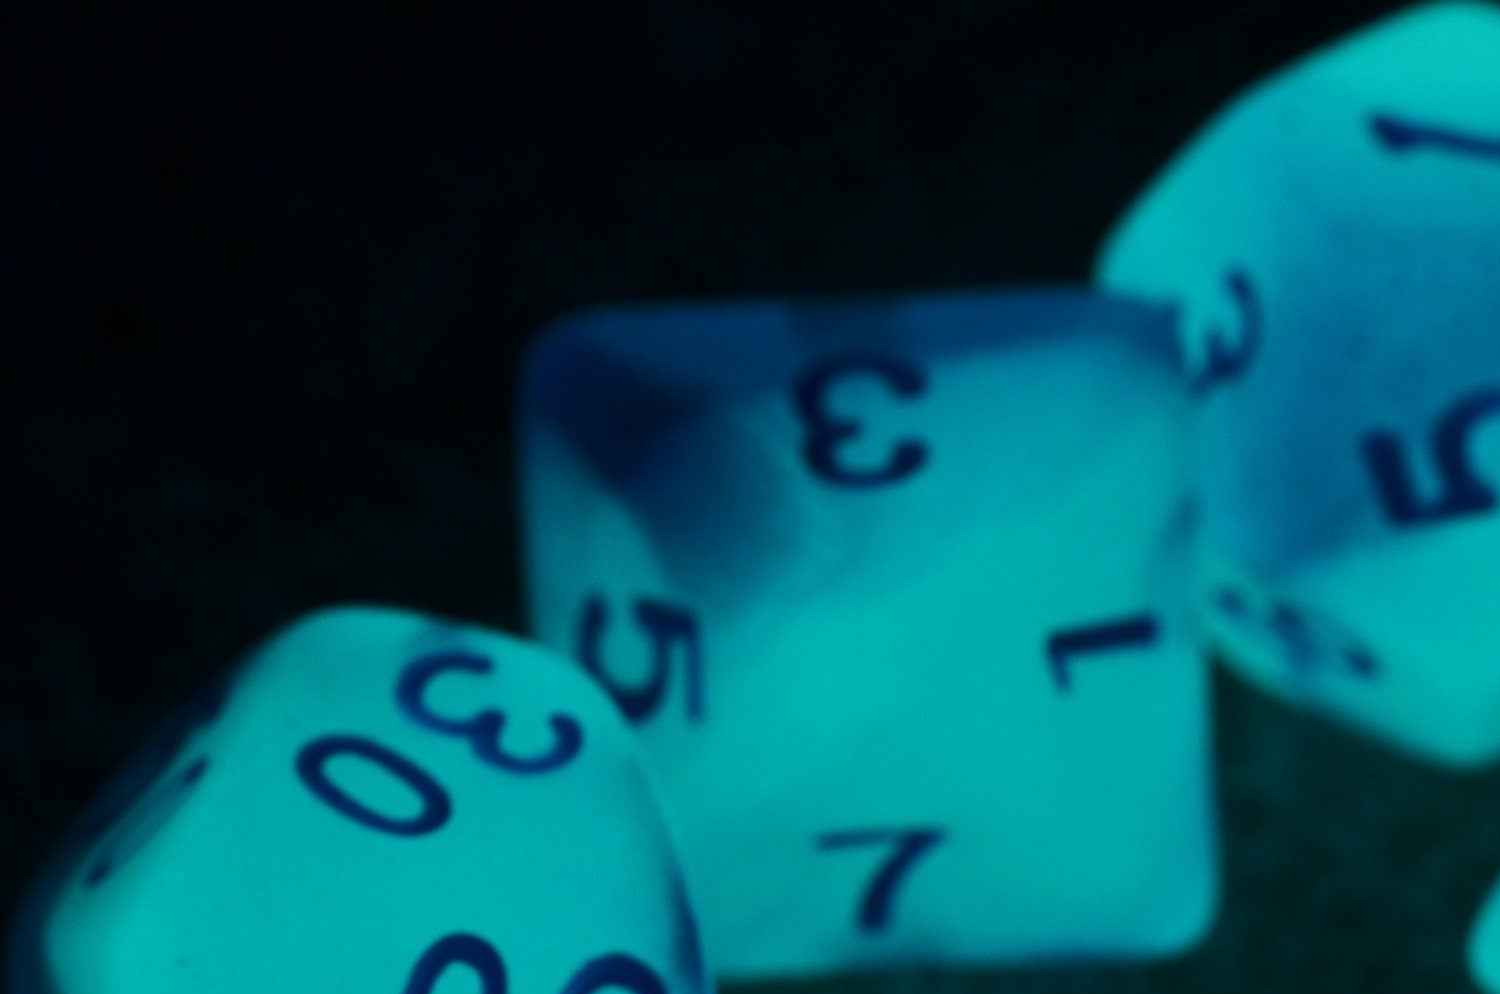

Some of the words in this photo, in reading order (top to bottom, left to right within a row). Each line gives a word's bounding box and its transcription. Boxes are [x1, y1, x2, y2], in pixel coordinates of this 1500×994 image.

[797, 350, 926, 488] 3
[577, 592, 702, 727] 5
[1047, 611, 1160, 693] 1
[293, 652, 583, 838] 30
[815, 827, 948, 933] 7
